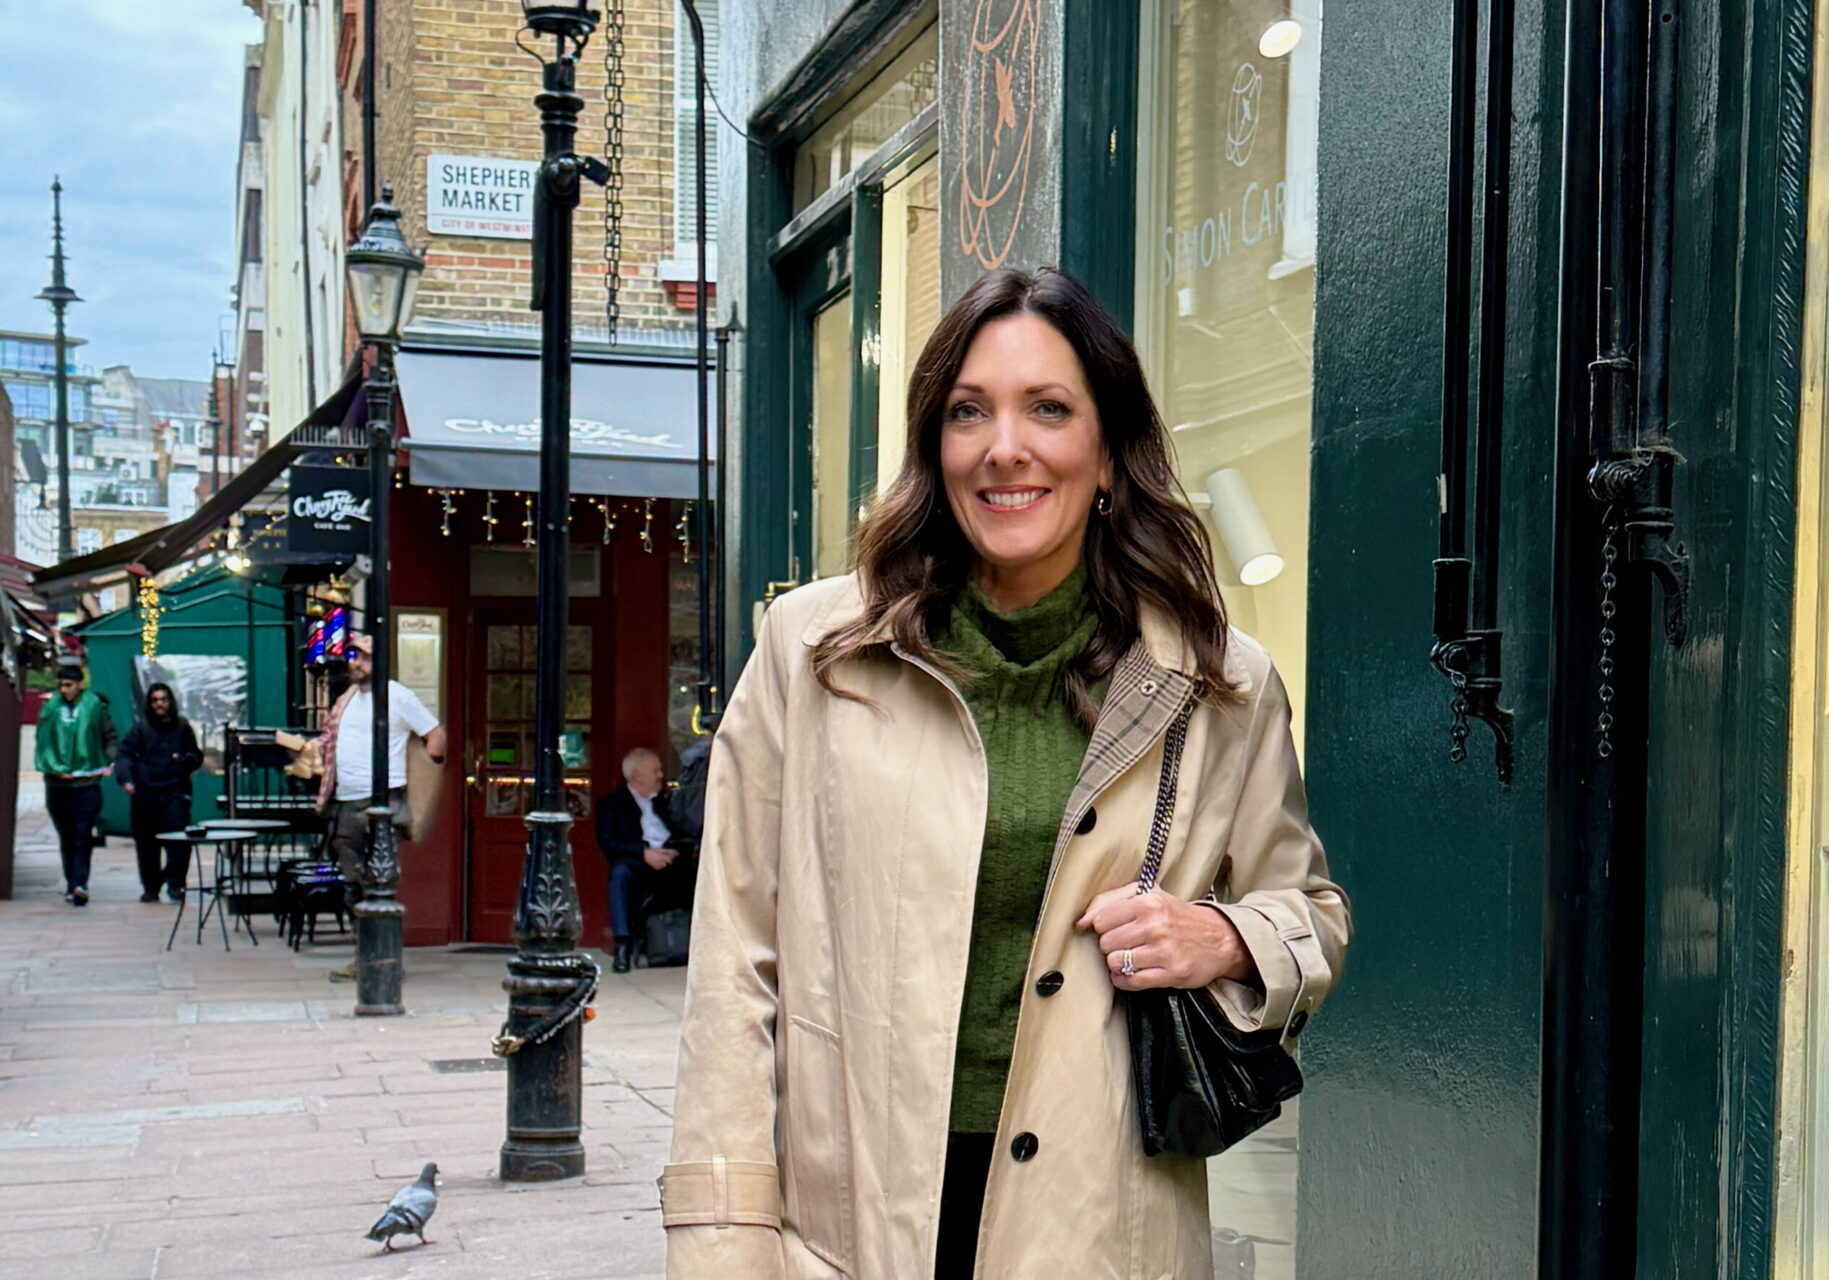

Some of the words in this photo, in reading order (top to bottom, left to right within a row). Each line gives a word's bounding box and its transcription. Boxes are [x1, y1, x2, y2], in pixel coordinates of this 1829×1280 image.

[442, 164, 530, 189] SHEPHER
[441, 188, 524, 212] MARKET
[442, 219, 461, 228] CITY
[464, 220, 475, 230] OF
[478, 222, 531, 233] WESTMINST
